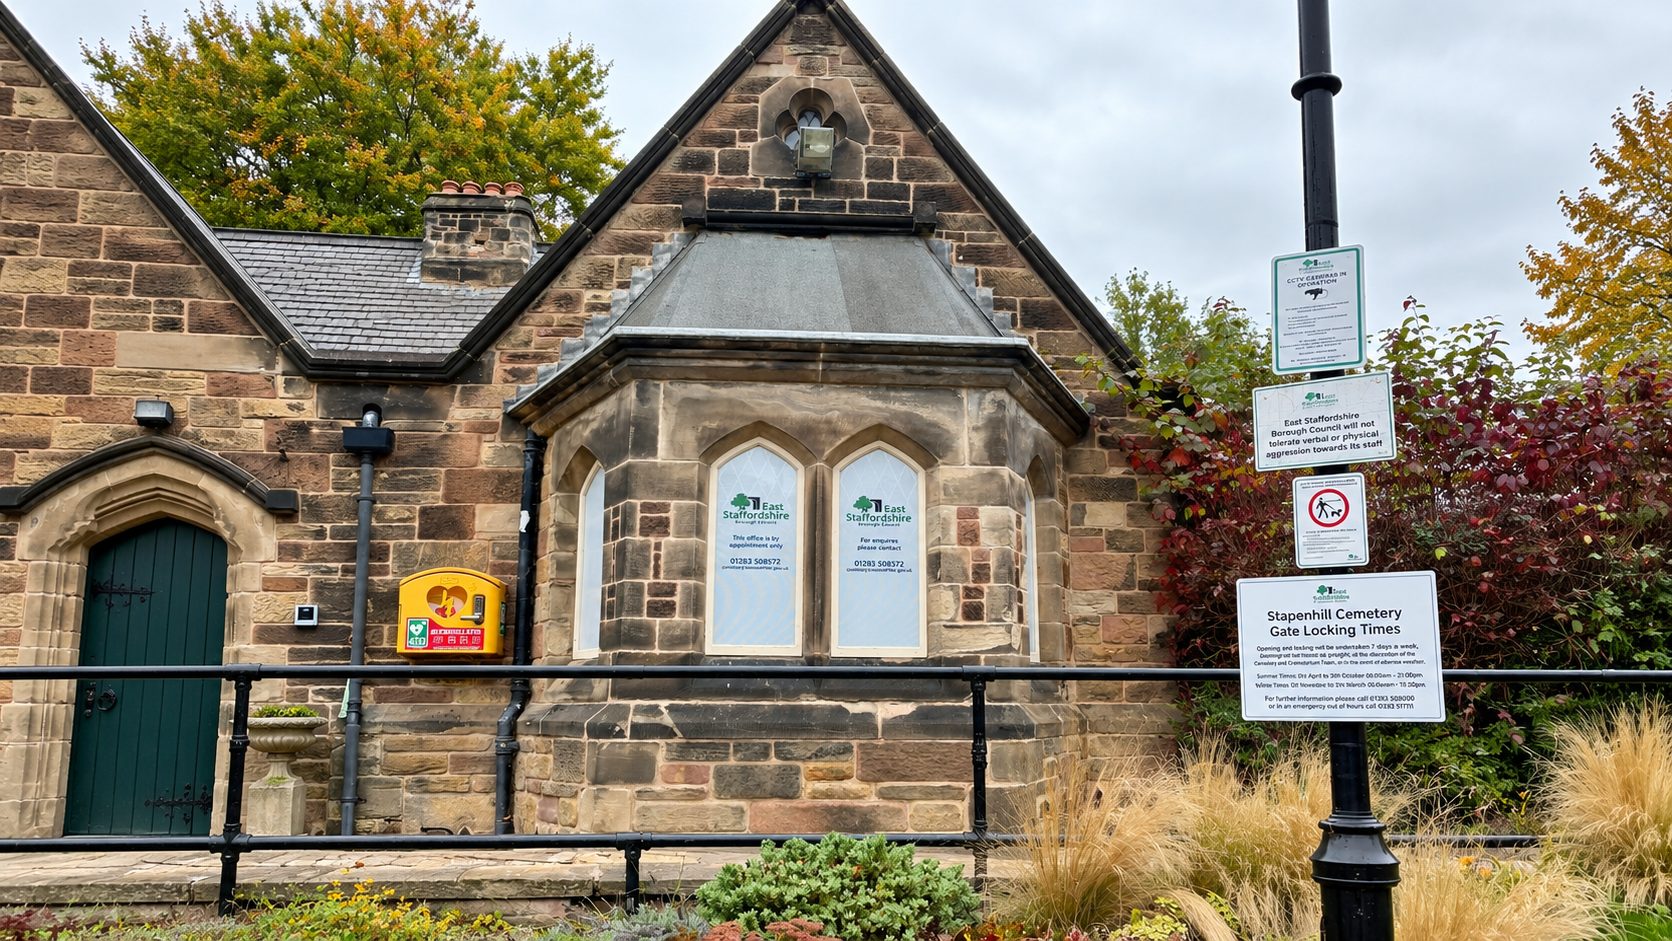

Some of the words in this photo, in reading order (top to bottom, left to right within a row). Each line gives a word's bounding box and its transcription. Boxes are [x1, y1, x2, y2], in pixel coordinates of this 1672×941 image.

[1284, 418, 1302, 427] East
[1304, 412, 1360, 425] Staffordshire
[1272, 427, 1307, 438] Borough
[1310, 424, 1341, 434] Council
[1344, 422, 1358, 430] will
[1360, 420, 1374, 428] not
[1269, 438, 1300, 448] tolerate
[1302, 436, 1328, 444] verbal
[1331, 434, 1340, 442] or
[1343, 430, 1379, 442] physical
[1266, 448, 1310, 458] aggression
[1313, 443, 1348, 453] towards
[1362, 440, 1382, 448] staff
[762, 502, 784, 510] East
[723, 511, 790, 520] Staffordshire
[846, 514, 912, 522] Staffordshire
[1268, 609, 1332, 624] Stapenhill
[1336, 608, 1402, 622] Cemetery
[1270, 626, 1300, 636] Gate
[1304, 624, 1356, 638] Locking
[1360, 623, 1401, 635] Times
